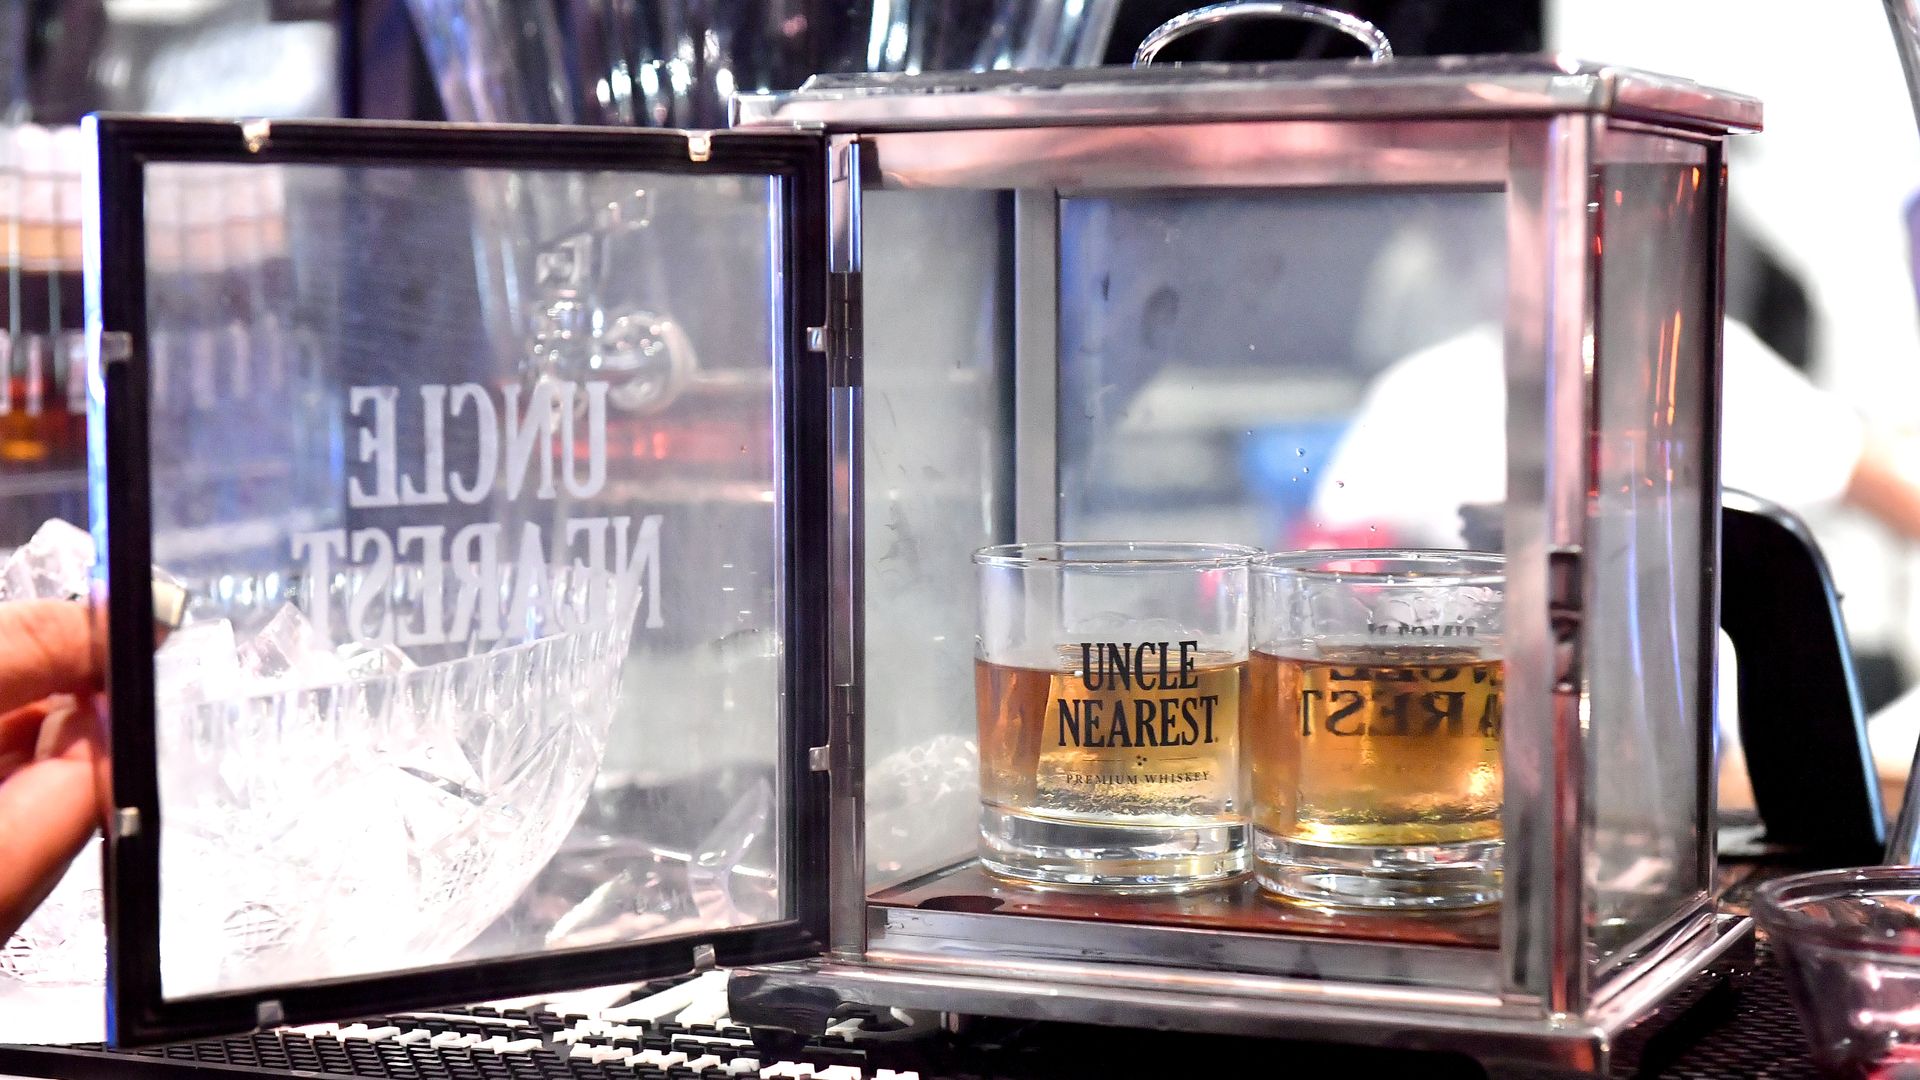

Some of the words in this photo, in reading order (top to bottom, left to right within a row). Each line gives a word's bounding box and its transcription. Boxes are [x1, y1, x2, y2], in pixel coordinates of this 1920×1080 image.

[1080, 640, 1199, 692] UNCLE
[1057, 694, 1219, 748] NEAREST
[1066, 773, 1138, 785] PREMIUM
[1144, 771, 1210, 784] WHISKEY
